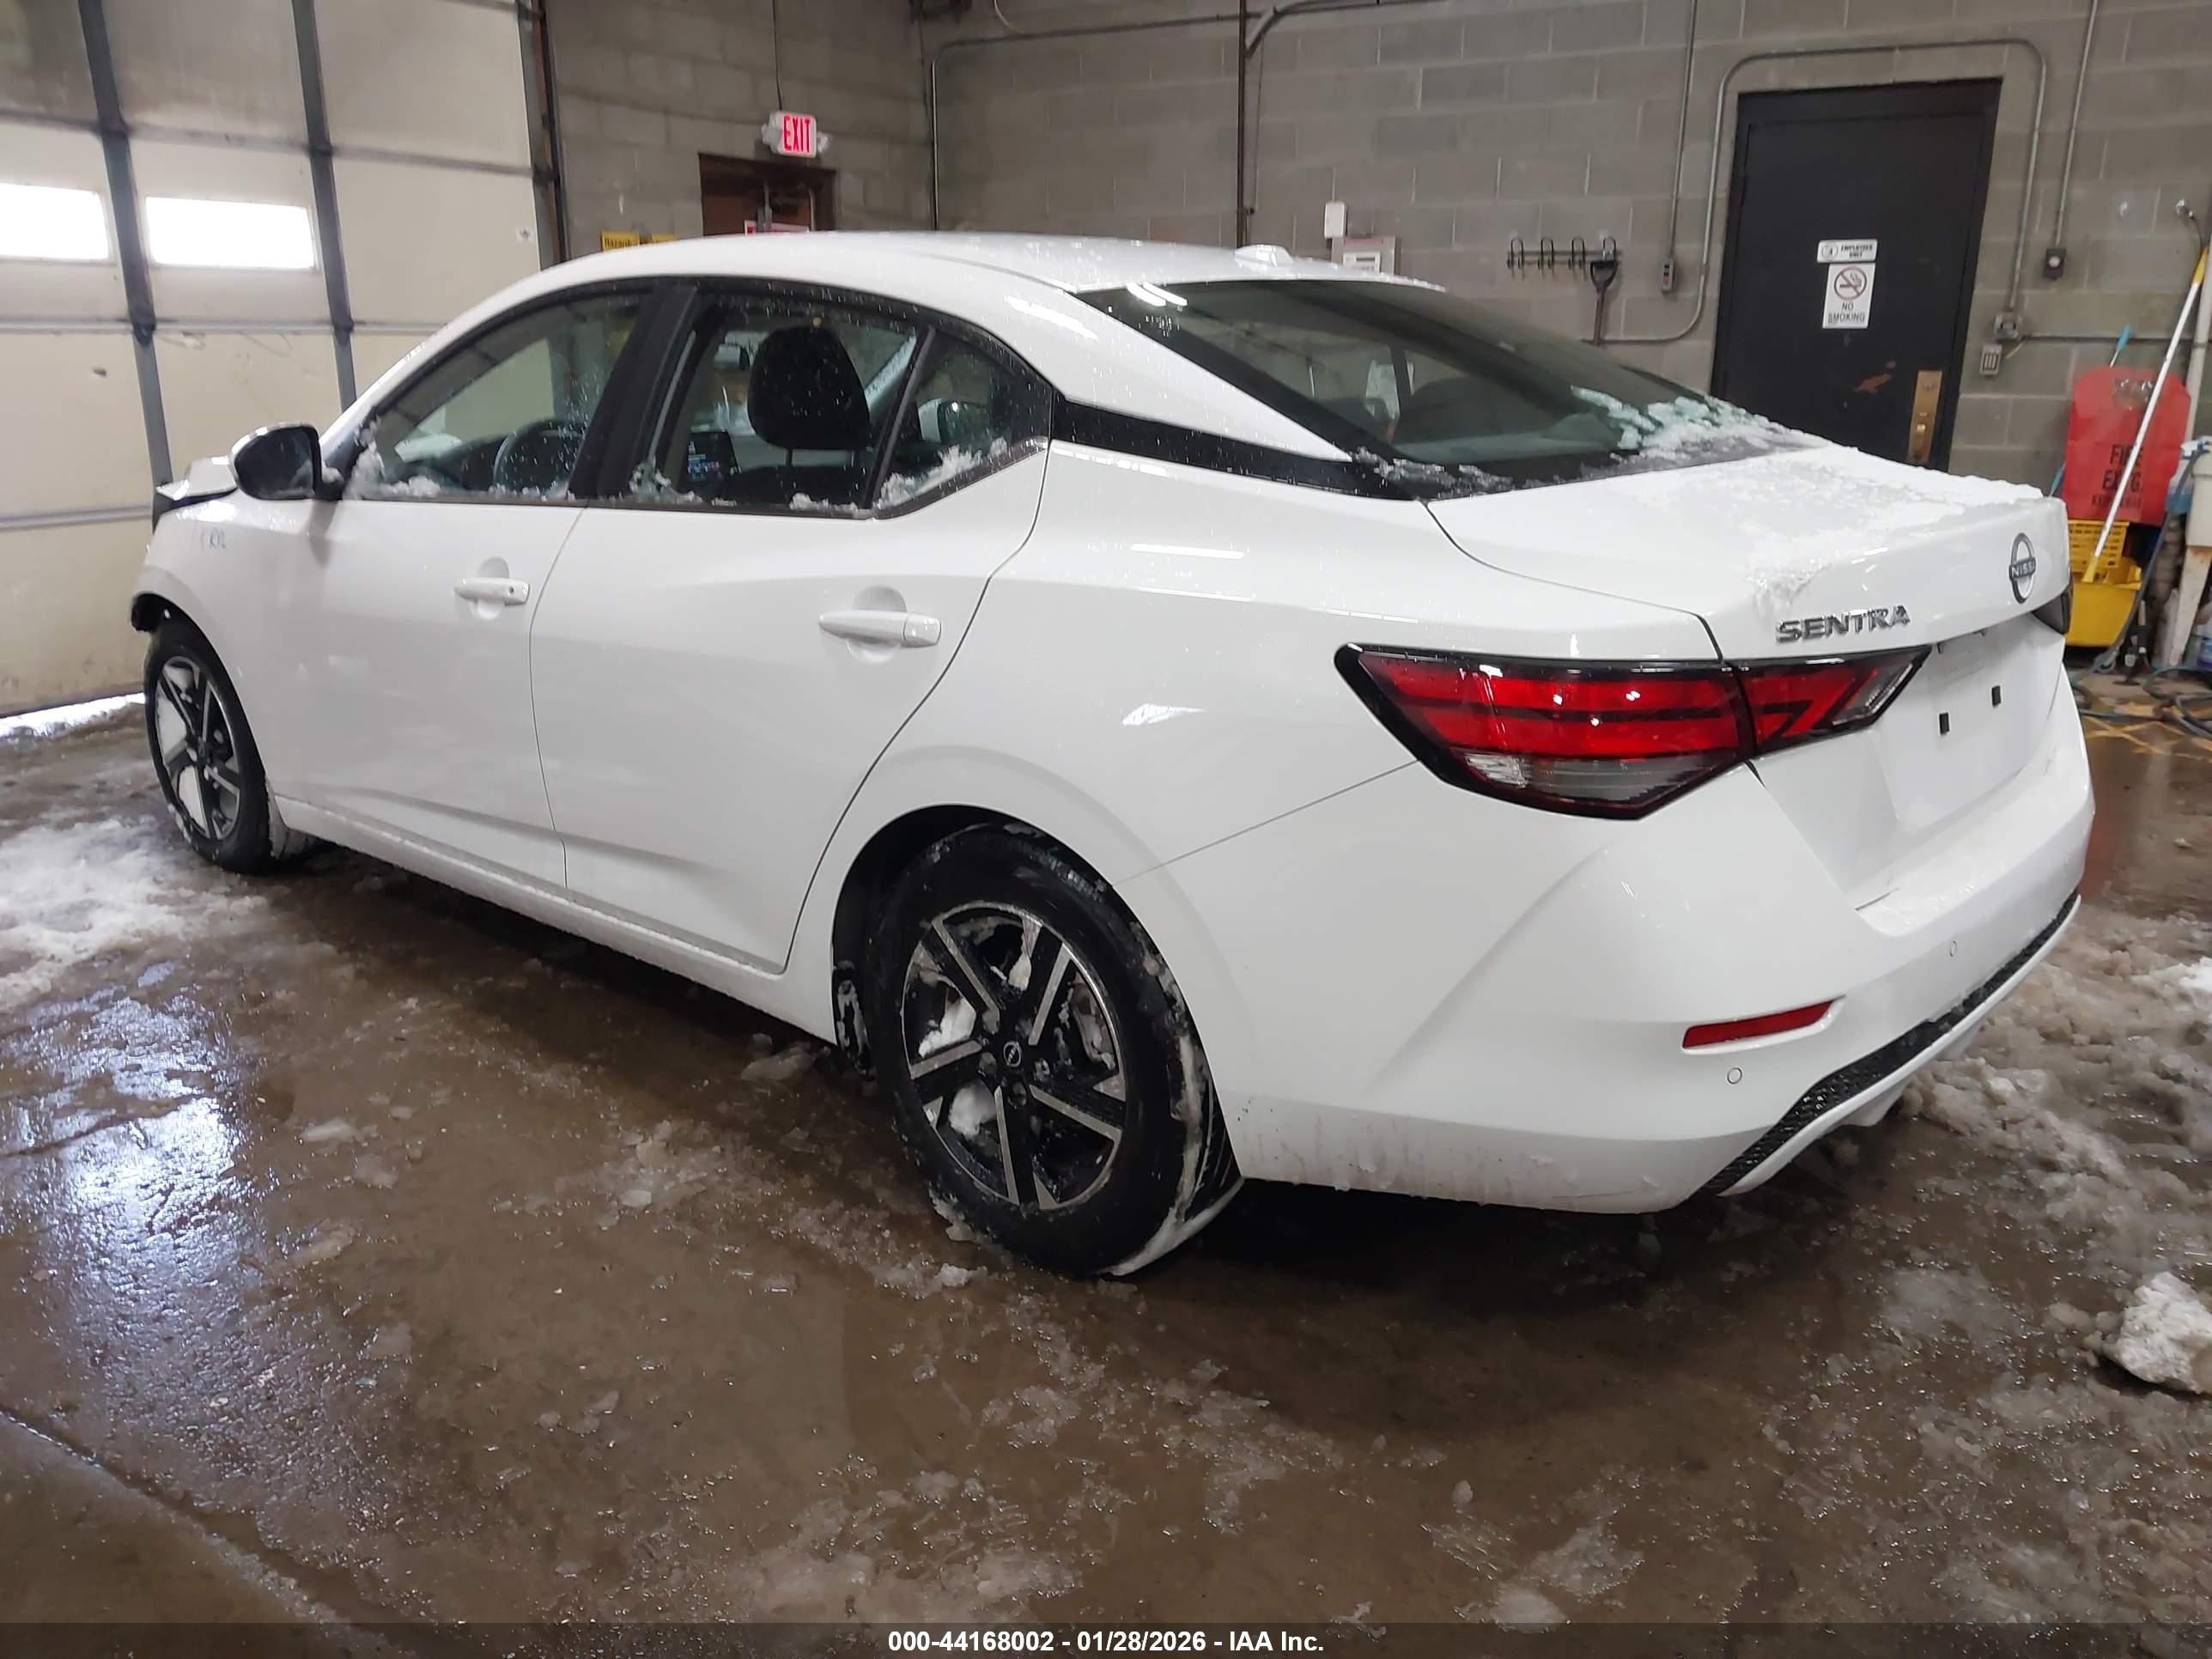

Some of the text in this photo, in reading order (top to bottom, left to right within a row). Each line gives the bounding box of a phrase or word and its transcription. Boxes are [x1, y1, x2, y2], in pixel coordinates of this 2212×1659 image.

[782, 114, 812, 154] EXIT
[1827, 311, 1866, 323] SMOKING
[1842, 301, 1855, 310] NO
[1775, 605, 1911, 643] SENTRA
